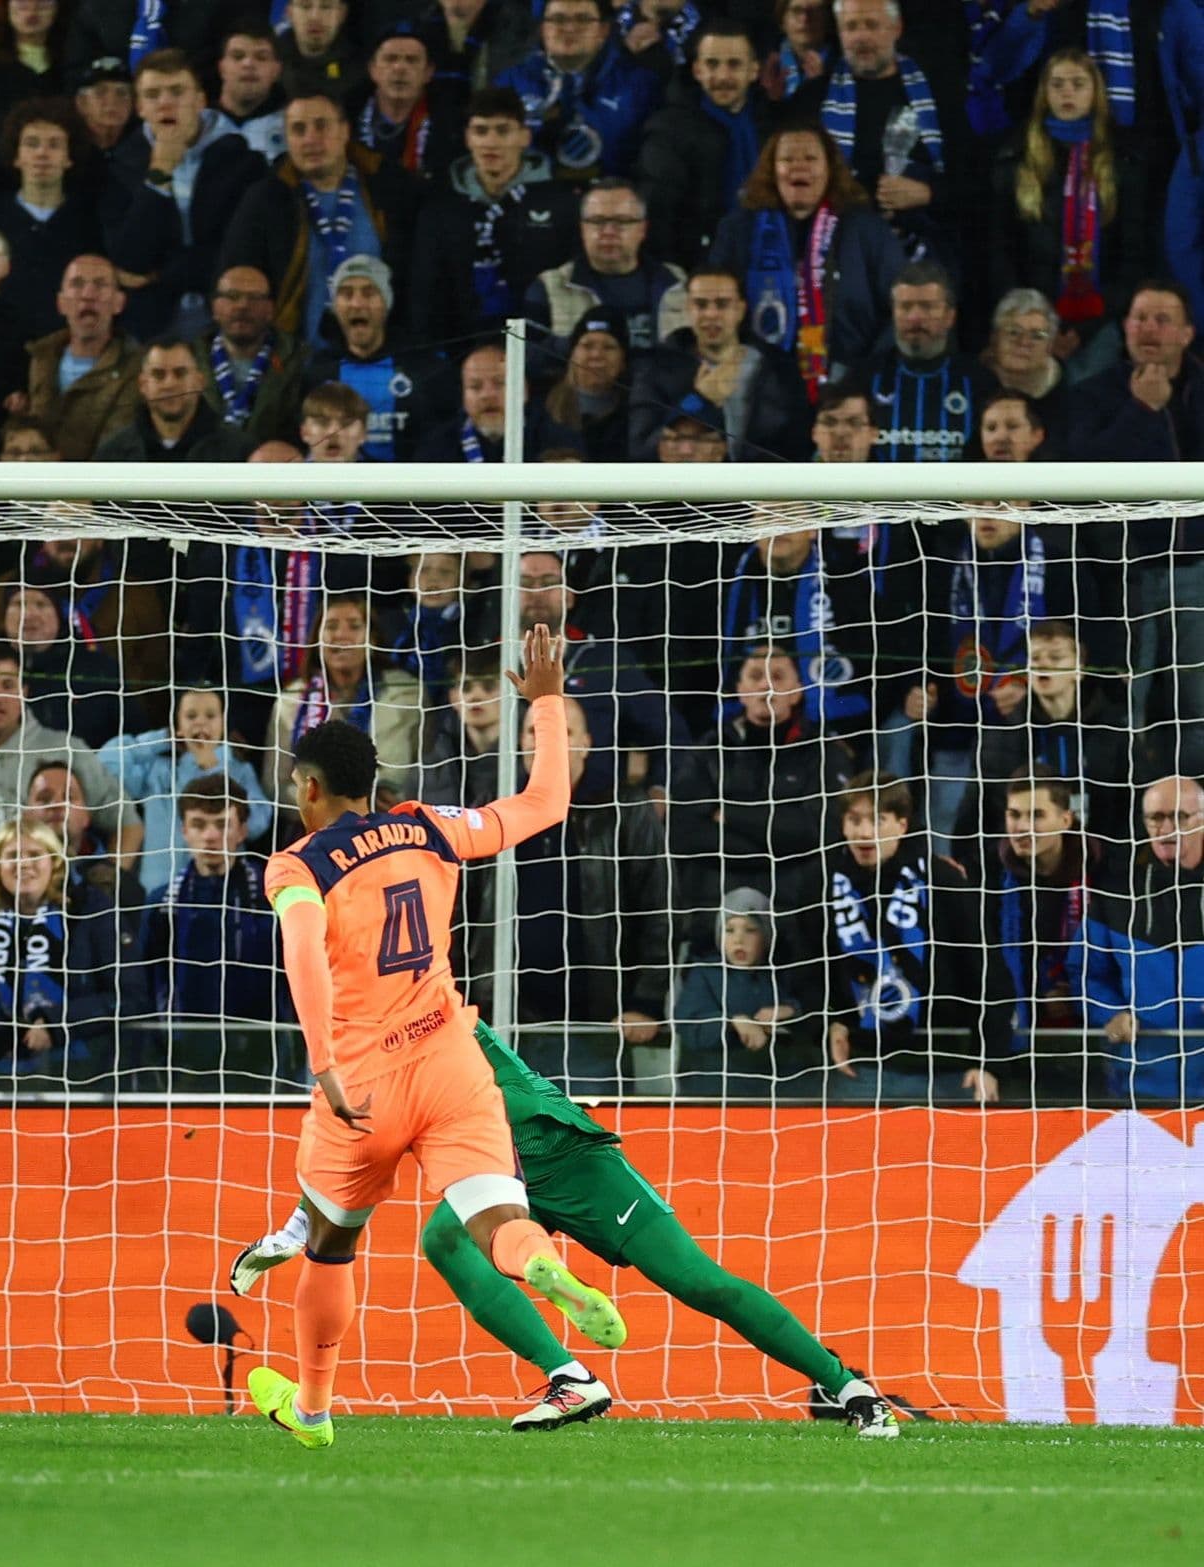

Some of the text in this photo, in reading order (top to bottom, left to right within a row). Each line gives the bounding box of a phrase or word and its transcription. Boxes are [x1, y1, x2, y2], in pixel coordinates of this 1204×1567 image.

[329, 823, 428, 872] R. ARAUJO
[376, 877, 434, 984] 4
[403, 1009, 443, 1032] UNHCR
[407, 1017, 447, 1041] ACNUR
